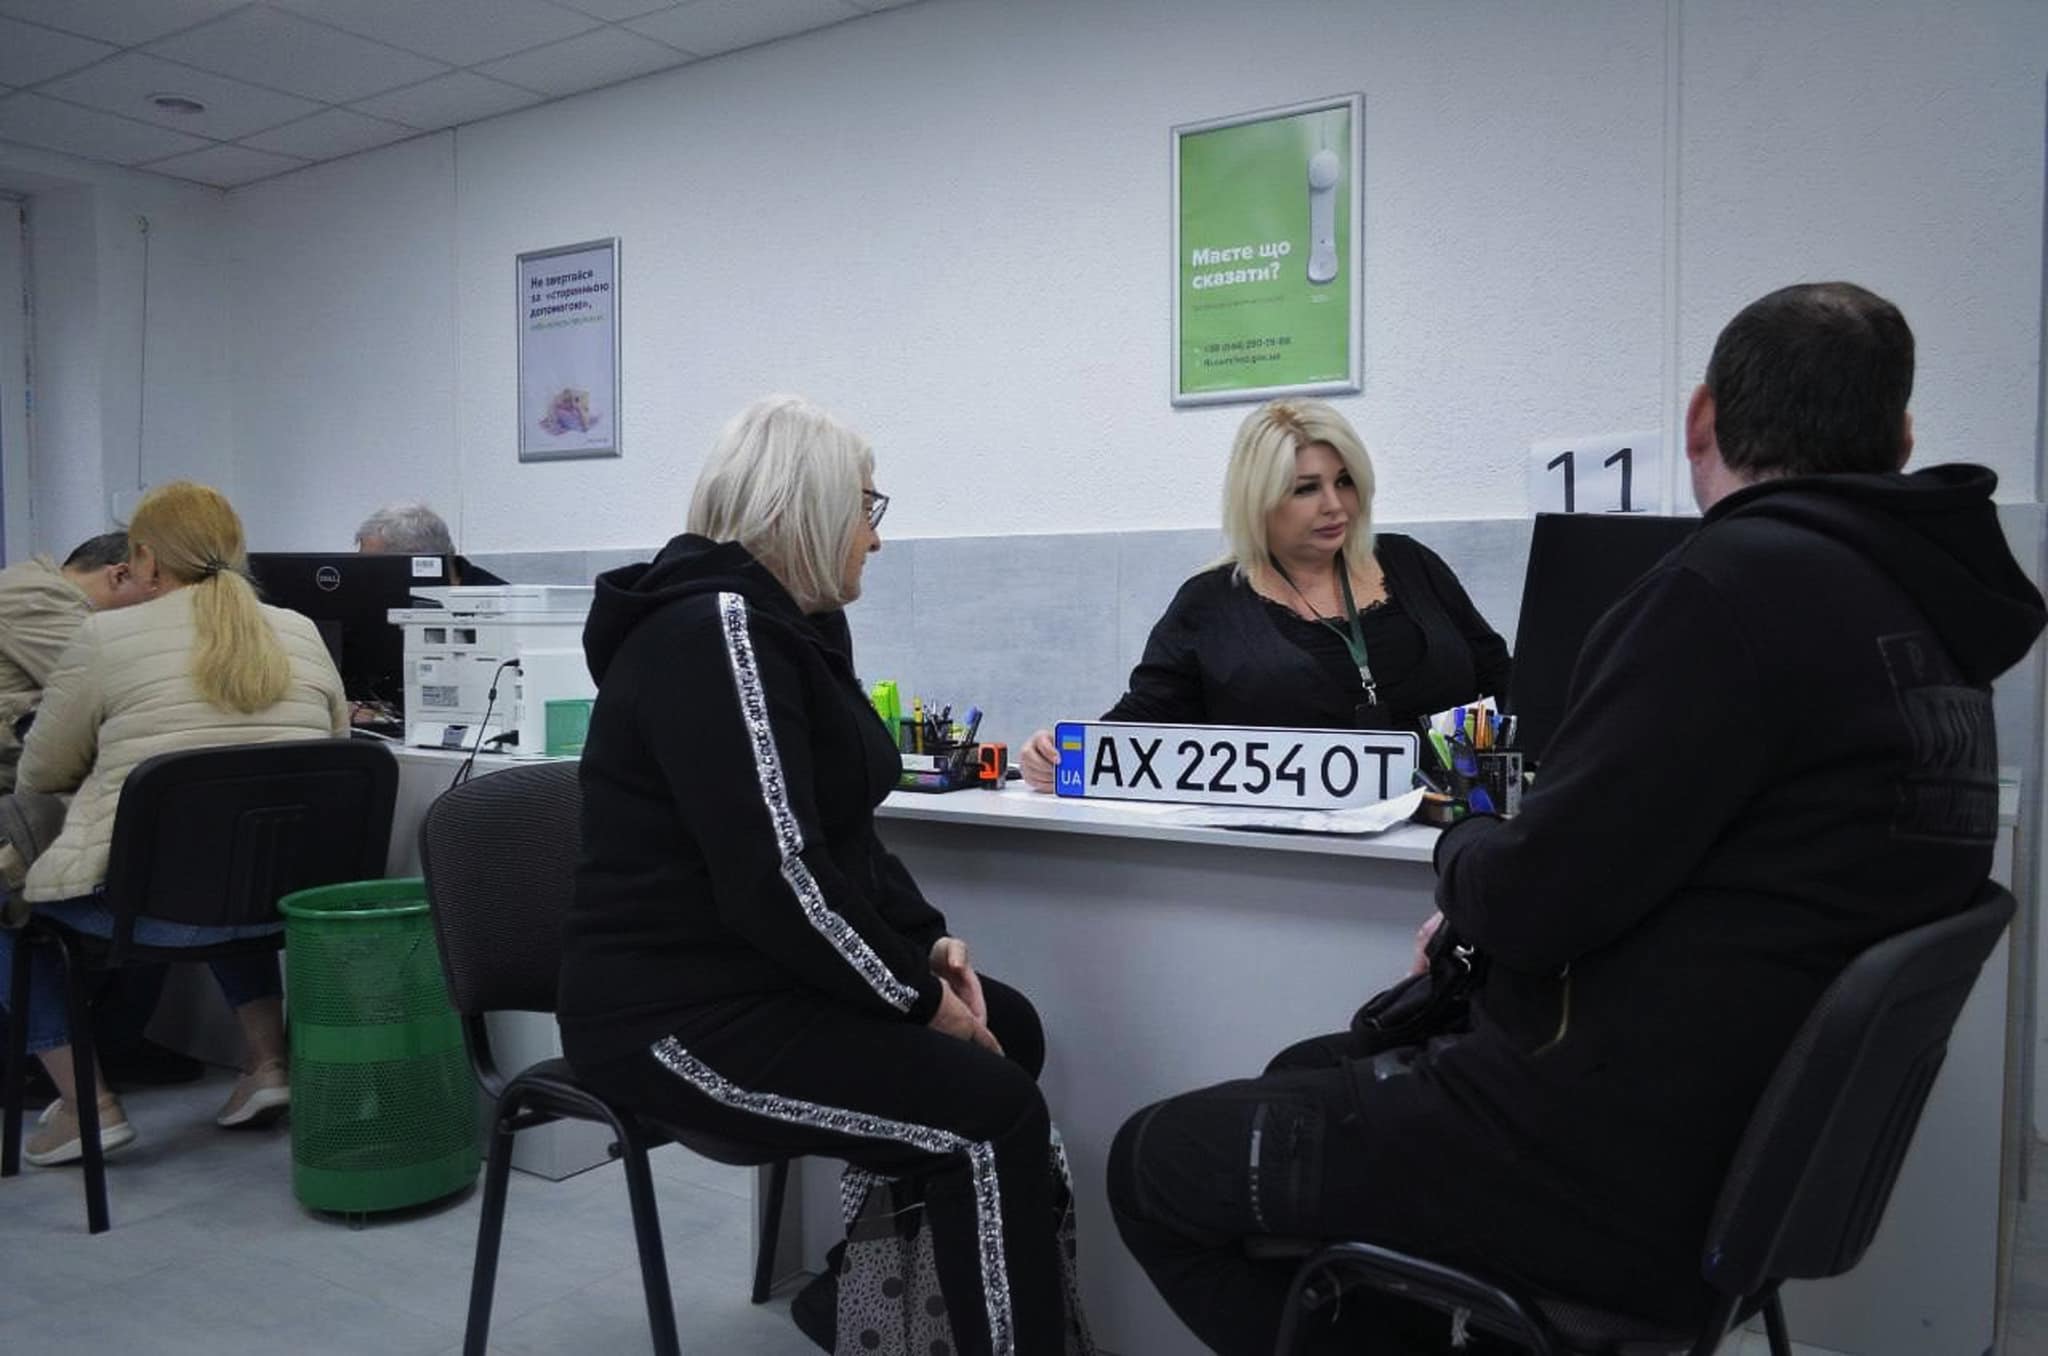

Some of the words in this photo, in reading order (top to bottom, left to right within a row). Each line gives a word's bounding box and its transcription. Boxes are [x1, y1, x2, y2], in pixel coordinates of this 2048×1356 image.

[1192, 246, 1253, 268] Маєте
[1260, 241, 1291, 259] що
[531, 276, 543, 289] Не
[1192, 261, 1281, 289] сказати?
[1546, 448, 1648, 513] 11
[1061, 770, 1082, 785] UA
[1091, 736, 1163, 789] AX
[1176, 740, 1306, 796] 2254
[1321, 745, 1405, 800] OT
